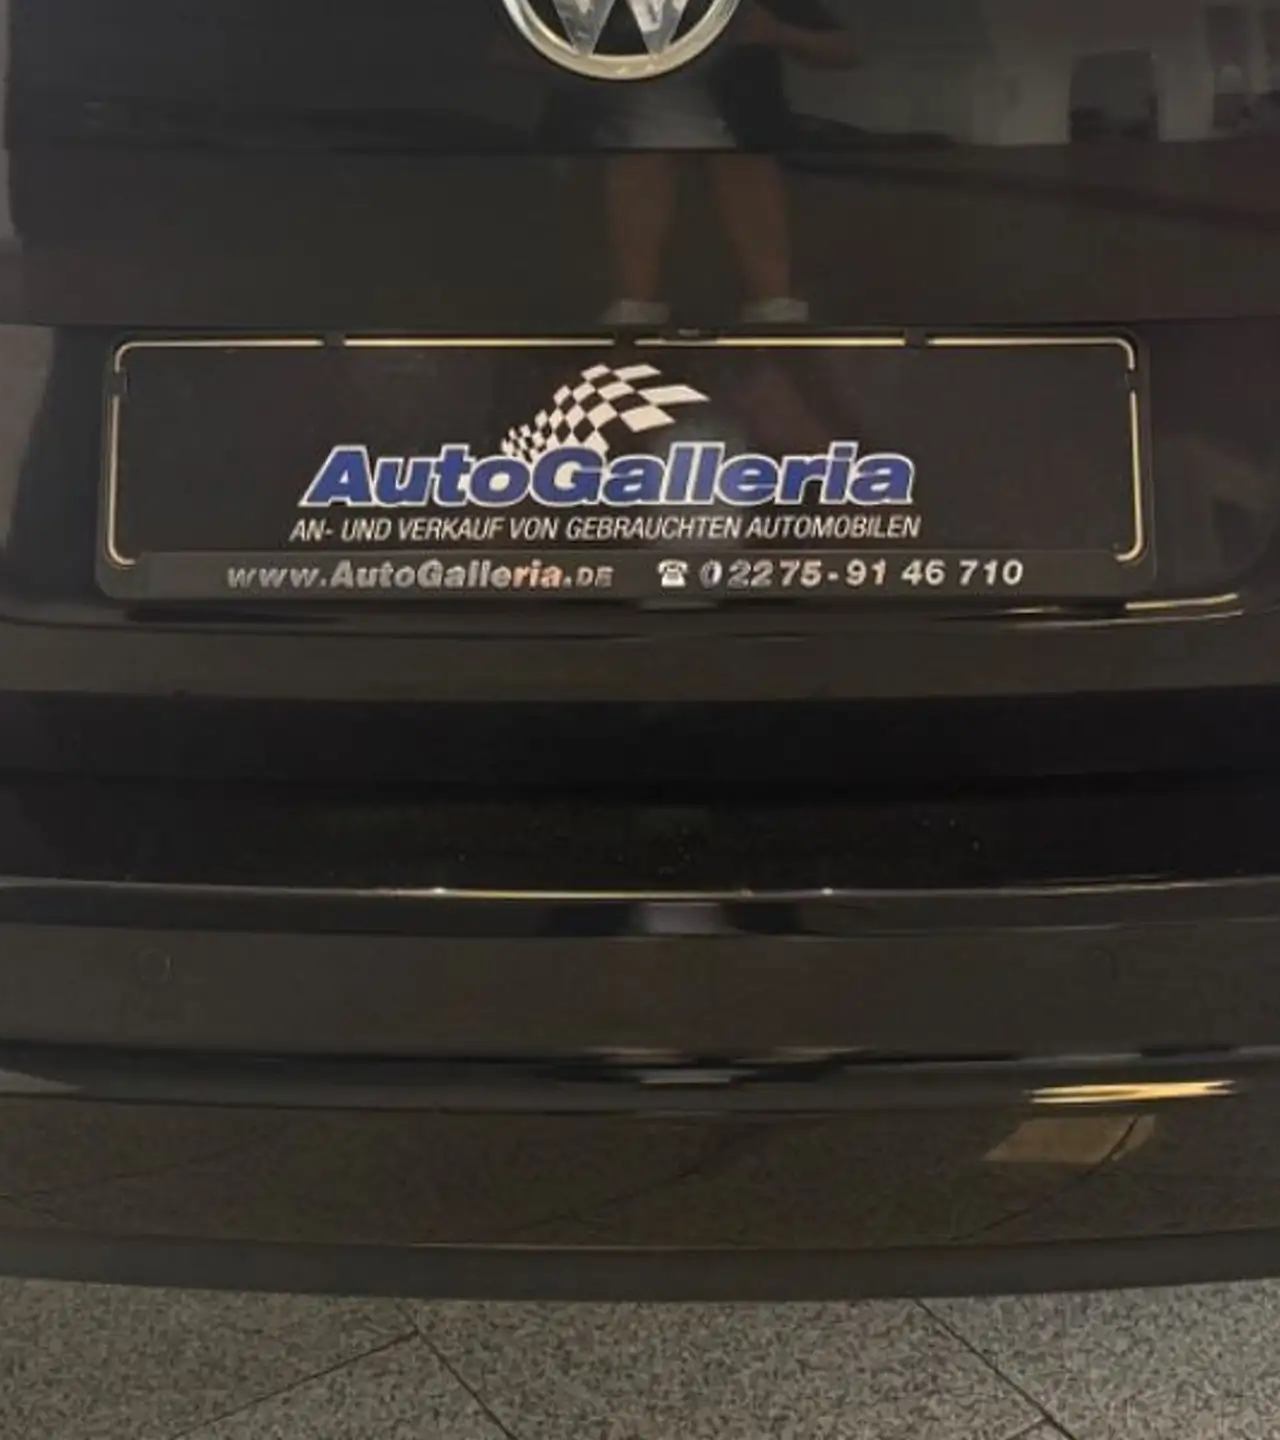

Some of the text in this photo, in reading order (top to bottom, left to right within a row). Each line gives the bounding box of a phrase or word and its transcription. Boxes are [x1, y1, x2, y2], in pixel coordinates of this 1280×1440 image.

[298, 443, 914, 507] AutoGalleria
[288, 514, 922, 542] AN- UND VERKAUF VON GEBRAUCHTEN AUTOMOBILEN
[901, 560, 946, 587] 46
[959, 560, 1024, 587] 710
